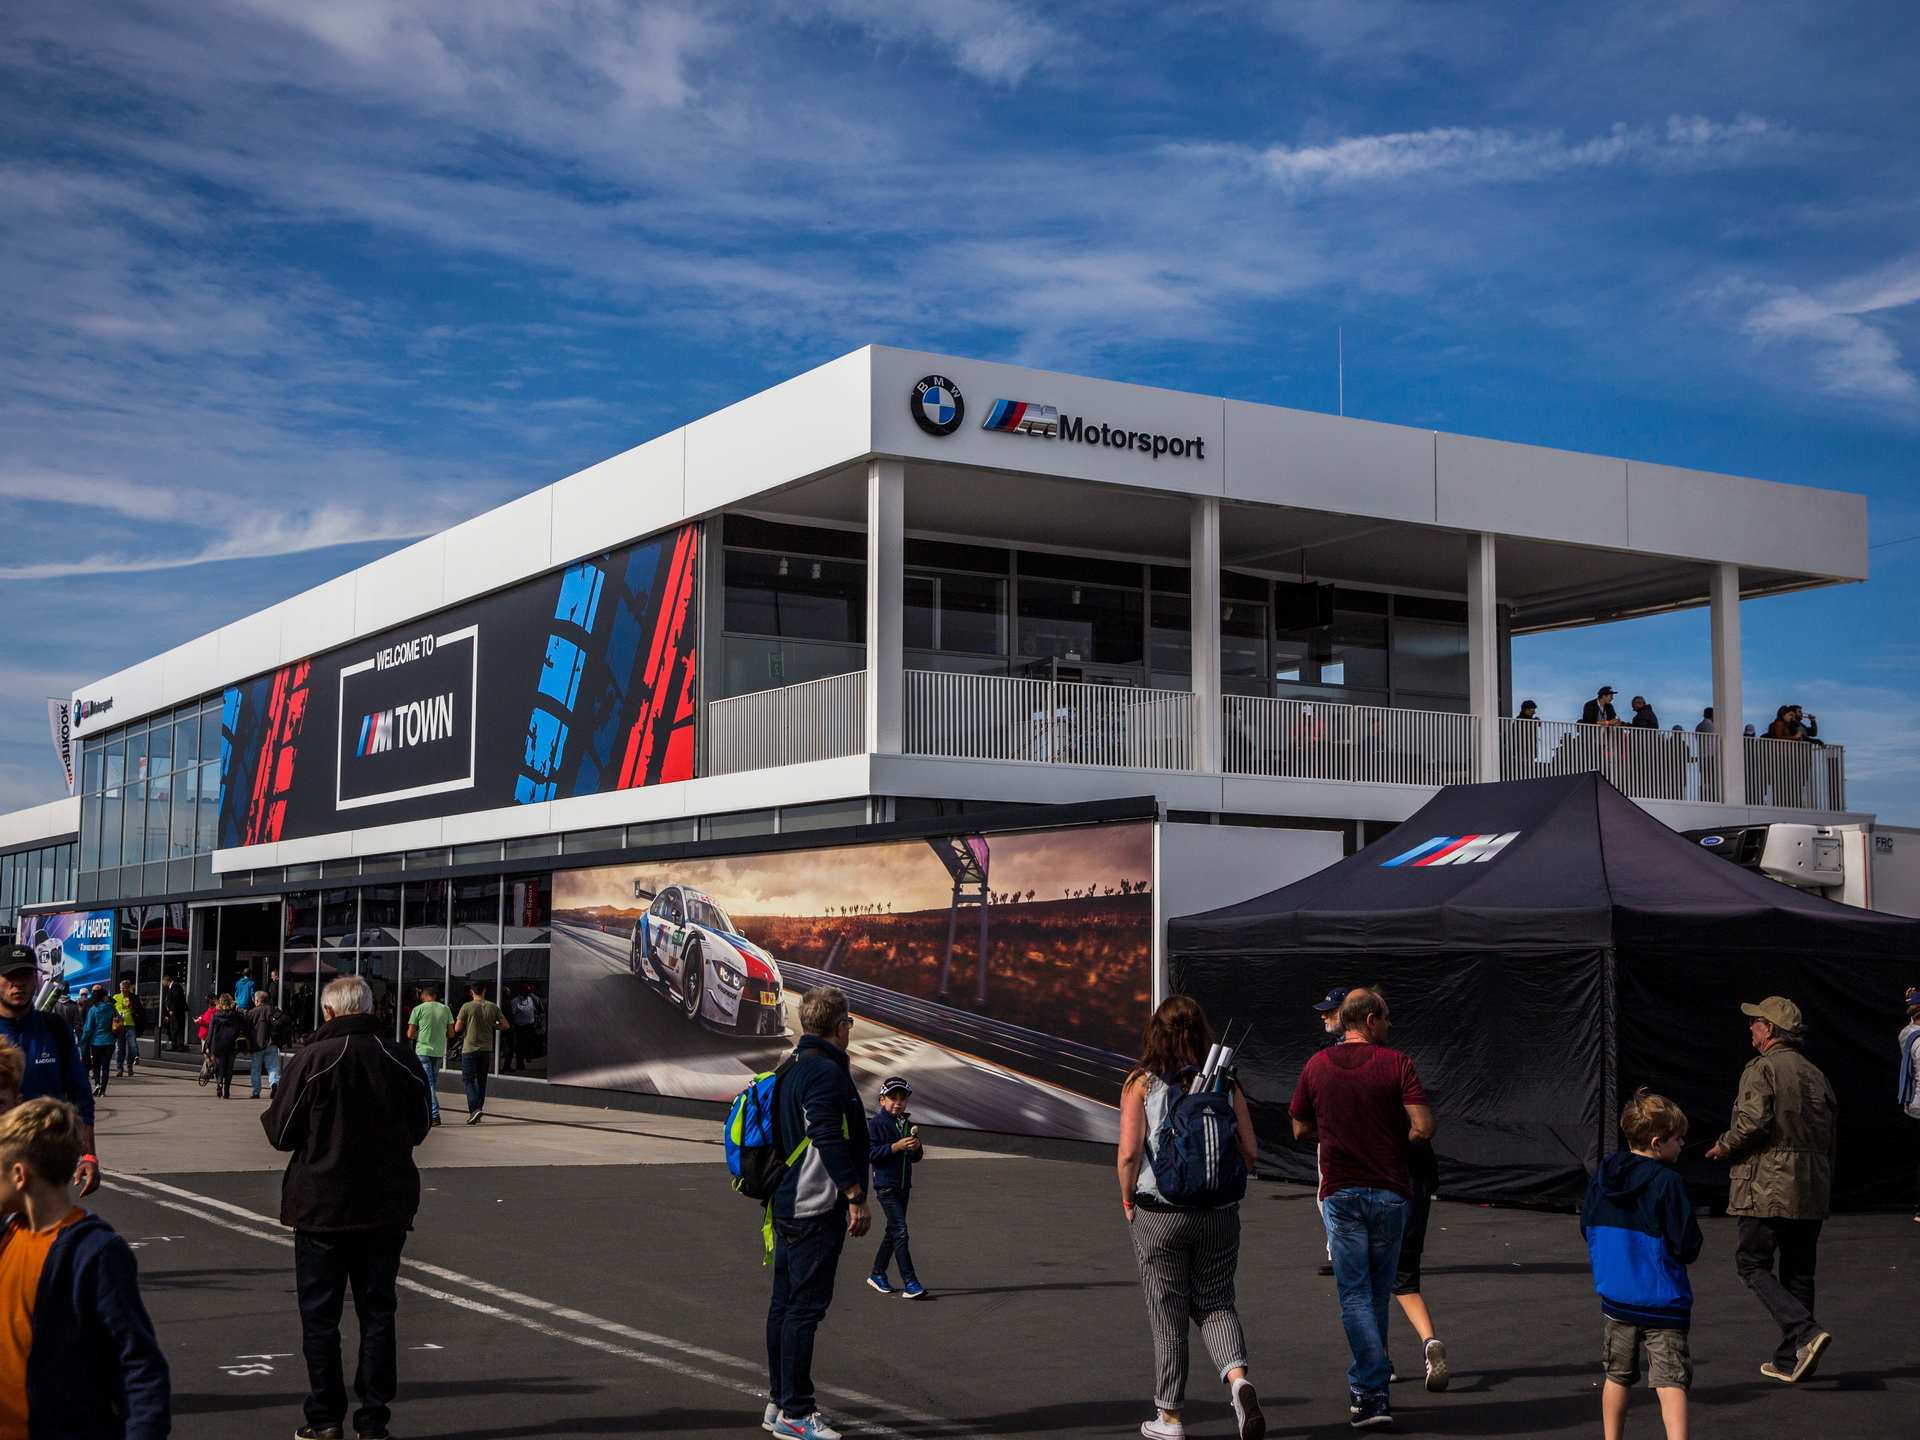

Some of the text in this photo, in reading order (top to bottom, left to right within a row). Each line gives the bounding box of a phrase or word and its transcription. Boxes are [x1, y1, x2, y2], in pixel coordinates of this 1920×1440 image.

[916, 376, 962, 399] BMW
[1060, 414, 1205, 459] Motorsport
[376, 634, 434, 672] WELCOME TO
[395, 692, 454, 748] TOWN
[1876, 837, 1893, 848] FRC
[73, 919, 87, 938] PLAY
